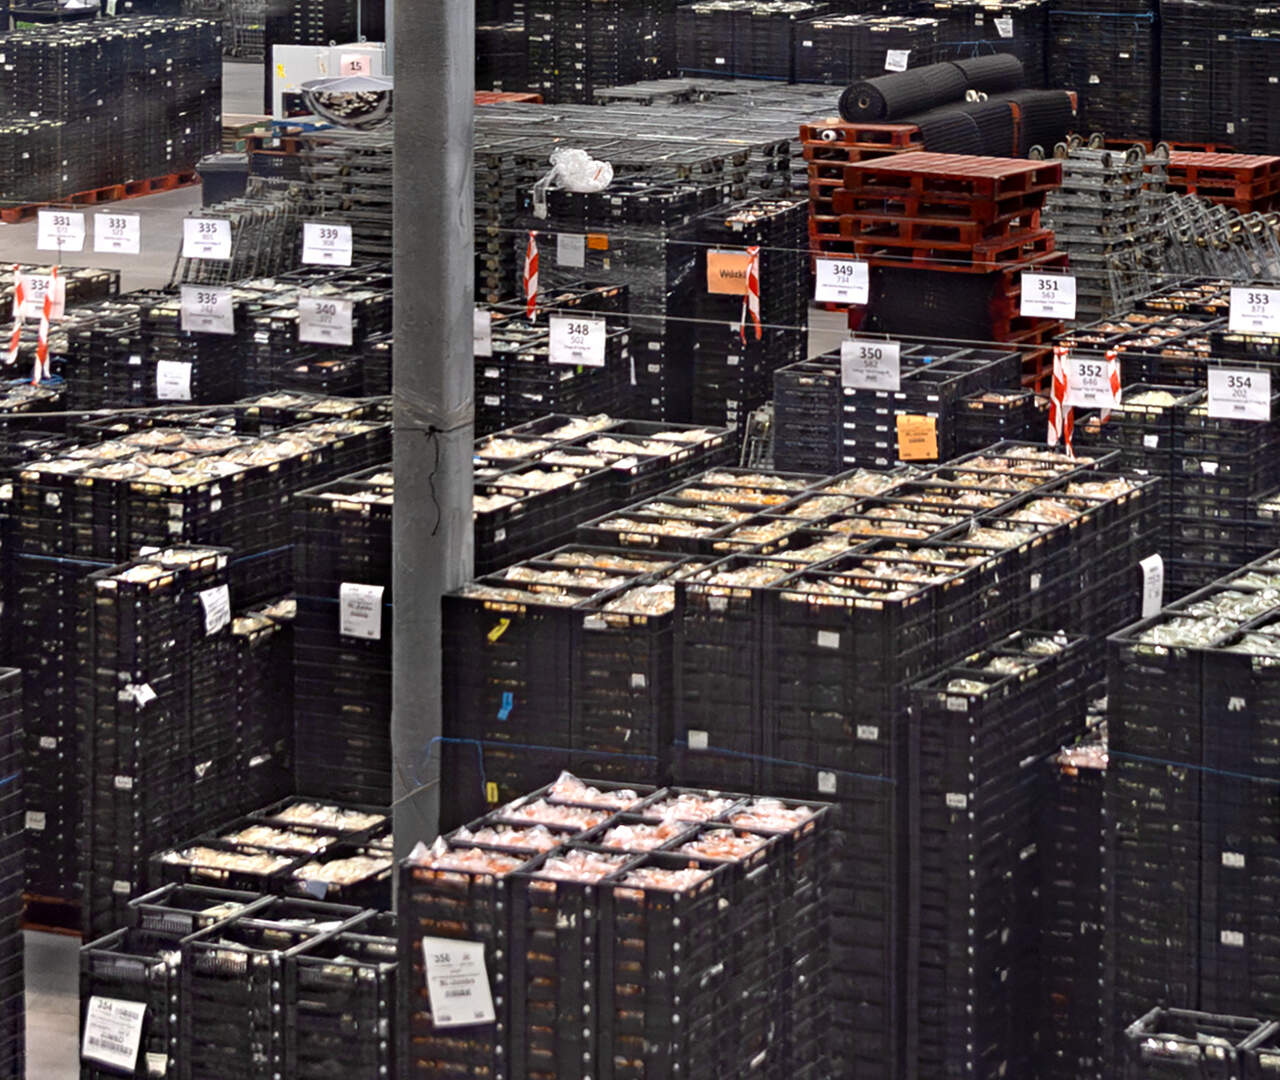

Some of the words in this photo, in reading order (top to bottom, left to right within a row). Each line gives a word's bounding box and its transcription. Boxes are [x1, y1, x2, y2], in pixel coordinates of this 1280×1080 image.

[350, 62, 362, 71] 15
[54, 216, 70, 226] 331
[110, 218, 126, 229] 333
[200, 223, 217, 233] 335
[320, 229, 338, 239] 339
[834, 265, 853, 276] 349
[32, 279, 49, 290] 334
[1039, 280, 1058, 291] 351
[198, 292, 217, 304] 336
[1248, 293, 1269, 304] 353
[316, 303, 336, 316] 340
[568, 323, 589, 335] 348
[859, 347, 882, 361] 350
[1079, 364, 1101, 377] 352
[1228, 376, 1251, 388] 354
